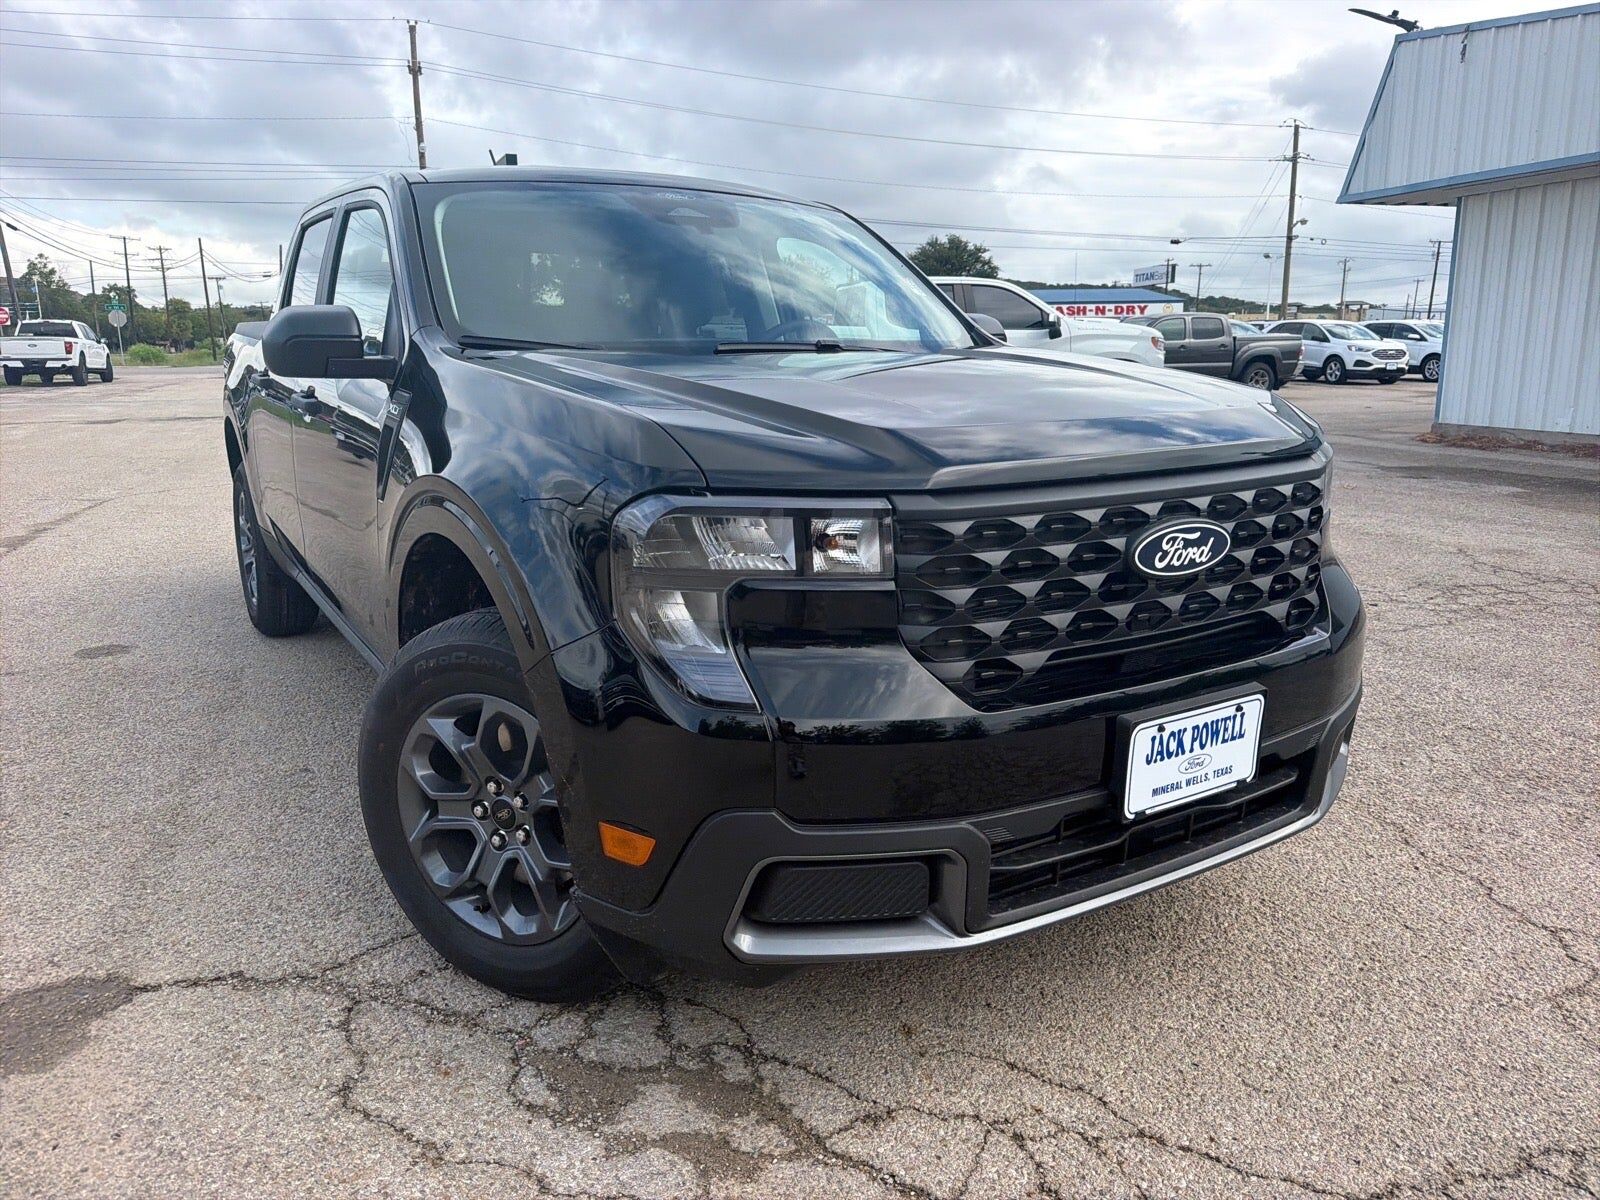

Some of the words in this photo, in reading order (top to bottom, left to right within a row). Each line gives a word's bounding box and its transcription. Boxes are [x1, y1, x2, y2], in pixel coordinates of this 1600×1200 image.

[1056, 304, 1149, 316] ASH-N-DRY
[1154, 531, 1215, 569] Ford
[1145, 727, 1188, 766] JACK
[1188, 711, 1246, 753] POWELL
[1184, 756, 1206, 771] Ford
[1151, 781, 1184, 798] MINERAL
[1185, 772, 1211, 788] WELLS,
[1212, 765, 1234, 780] TEXAS
